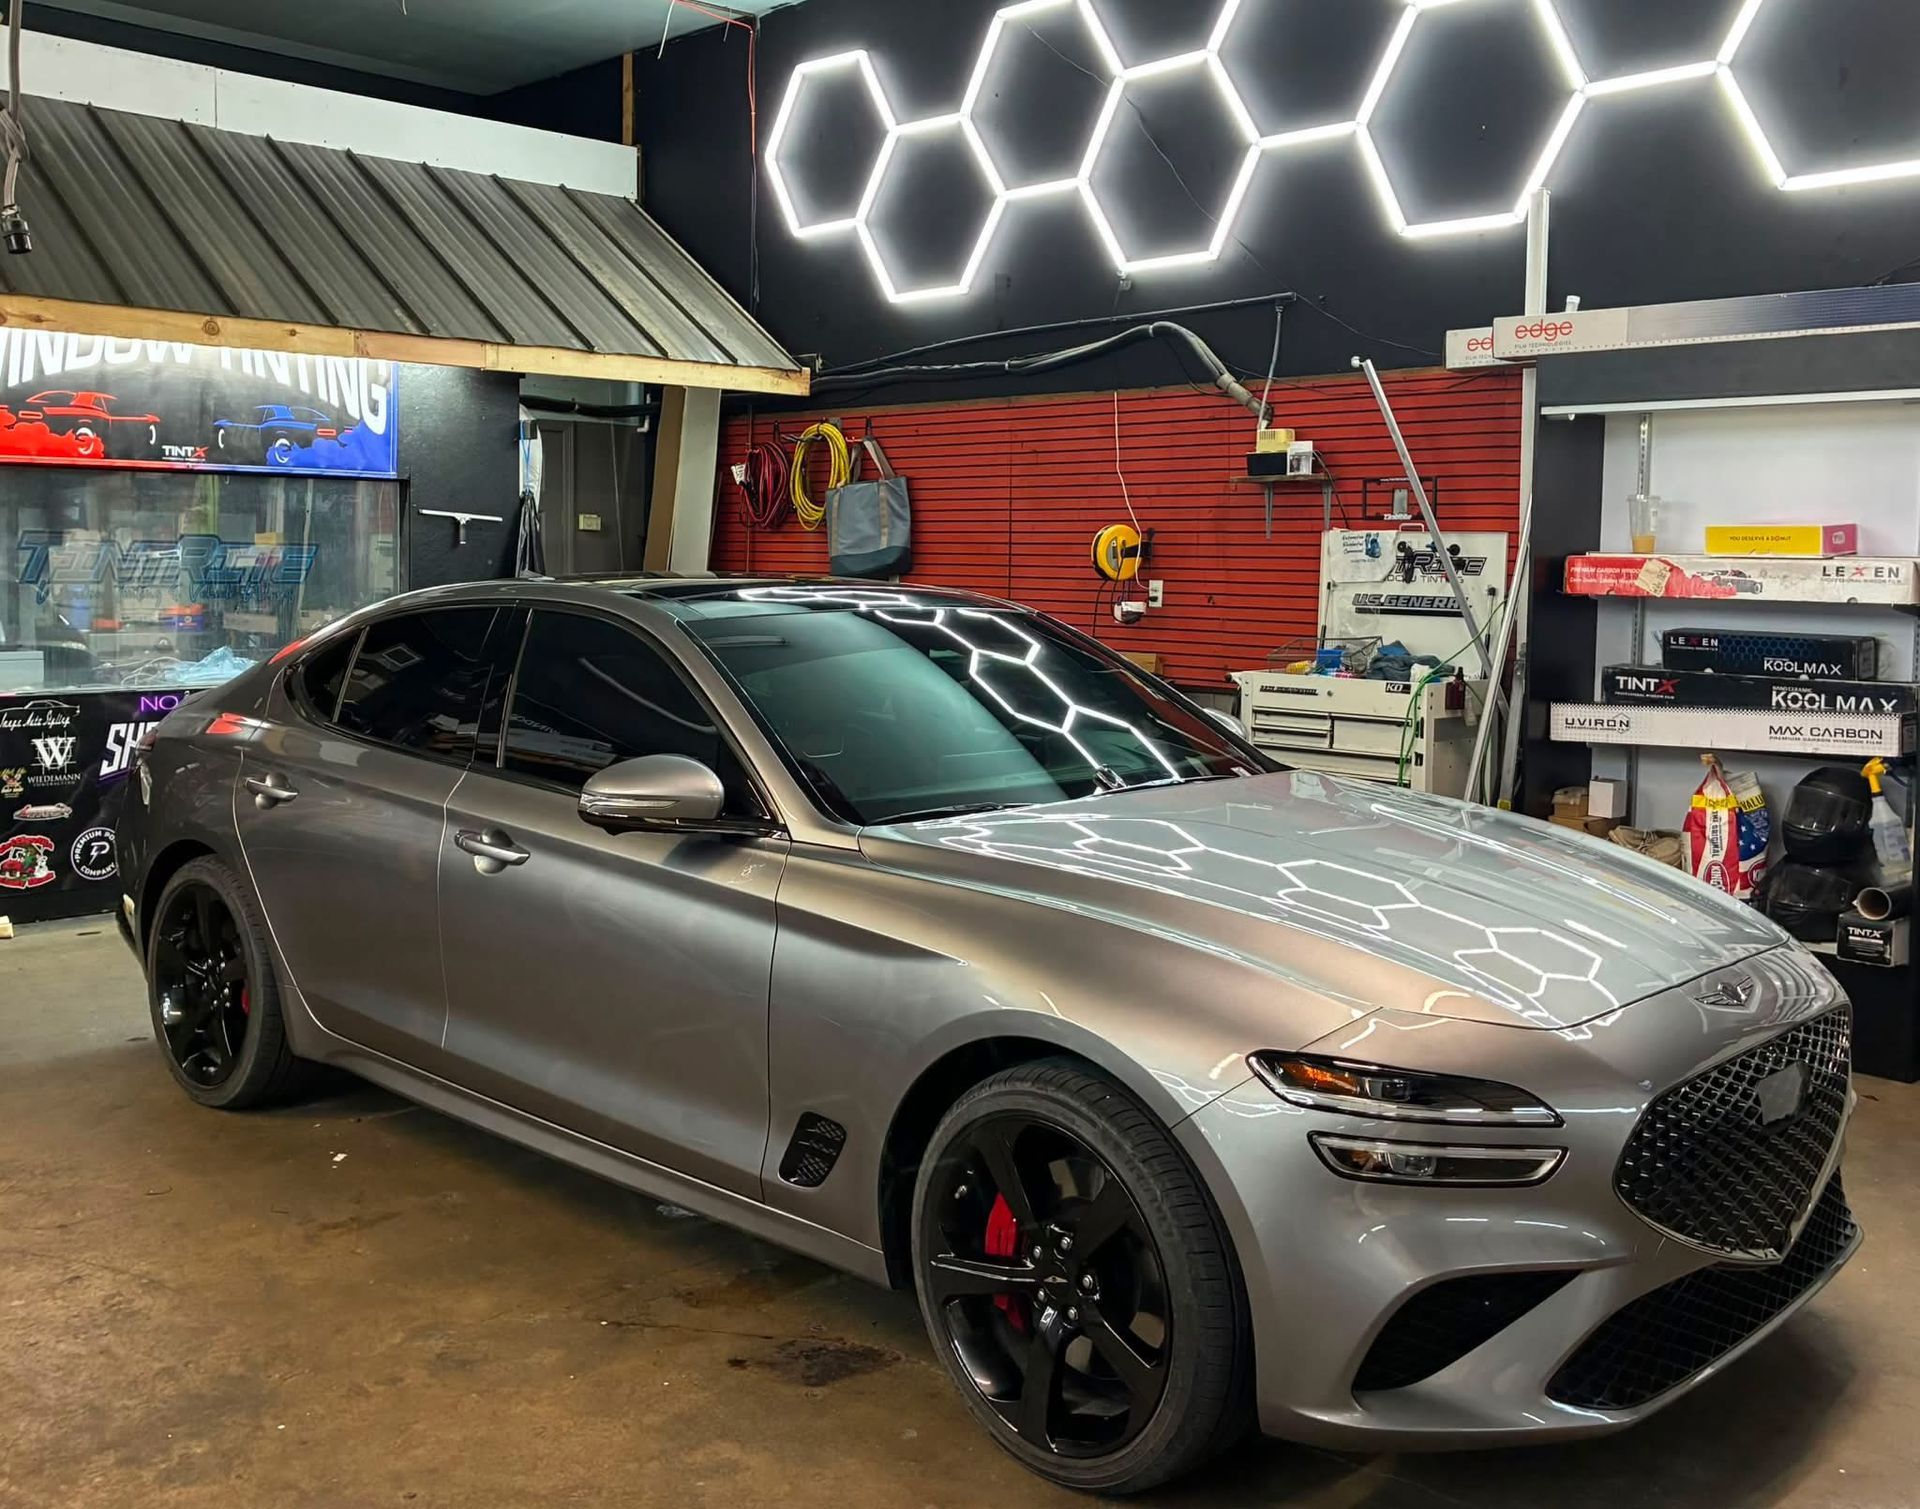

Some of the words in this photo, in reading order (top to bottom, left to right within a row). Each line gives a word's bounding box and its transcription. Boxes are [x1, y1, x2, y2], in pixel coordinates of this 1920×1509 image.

[1515, 318, 1573, 342] edge
[0, 327, 192, 388] INDOW
[161, 445, 209, 458] TINTX
[1822, 565, 1900, 579] LEXEN
[1383, 594, 1461, 610] GENERA
[1670, 636, 1719, 646] LEXEN
[1763, 660, 1842, 676] KOOLMAX
[1615, 676, 1681, 694] TINTX
[140, 694, 179, 712] NO
[1771, 690, 1899, 713] KOOLMAX
[1565, 718, 1629, 728] UVIRON
[1769, 725, 1803, 736] MAX
[1810, 727, 1883, 740] CARBON
[99, 722, 161, 776] SH
[80, 861, 116, 876] COMPANY
[1847, 926, 1885, 938] TINTX
